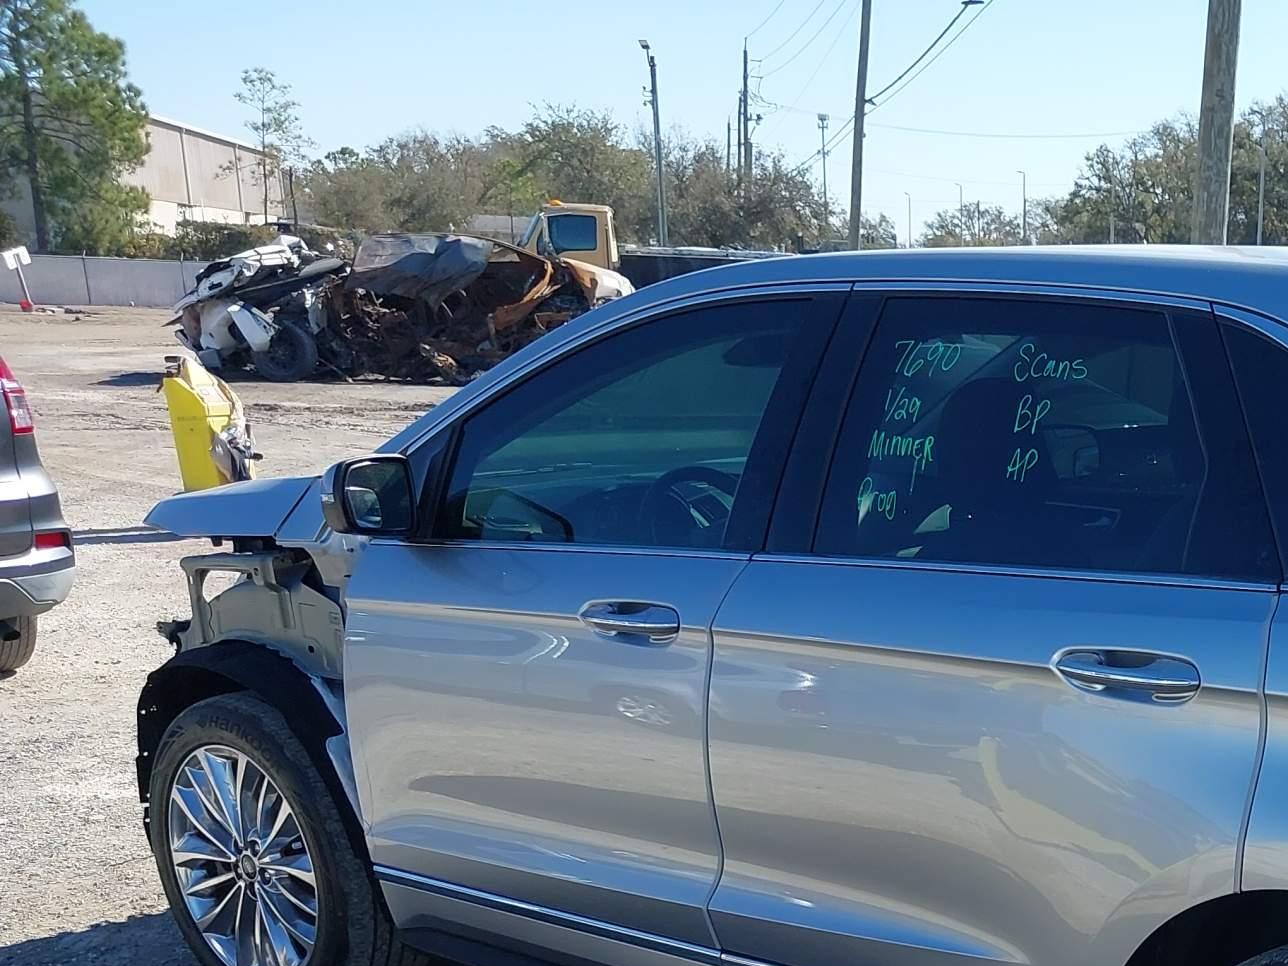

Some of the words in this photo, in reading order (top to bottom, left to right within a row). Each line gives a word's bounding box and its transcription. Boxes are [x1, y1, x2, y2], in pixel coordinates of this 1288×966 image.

[895, 340, 961, 377] 7690
[885, 386, 921, 423] 1/29
[1013, 395, 1051, 434] BP
[1006, 448, 1039, 482] AP
[857, 476, 897, 521] Prog
